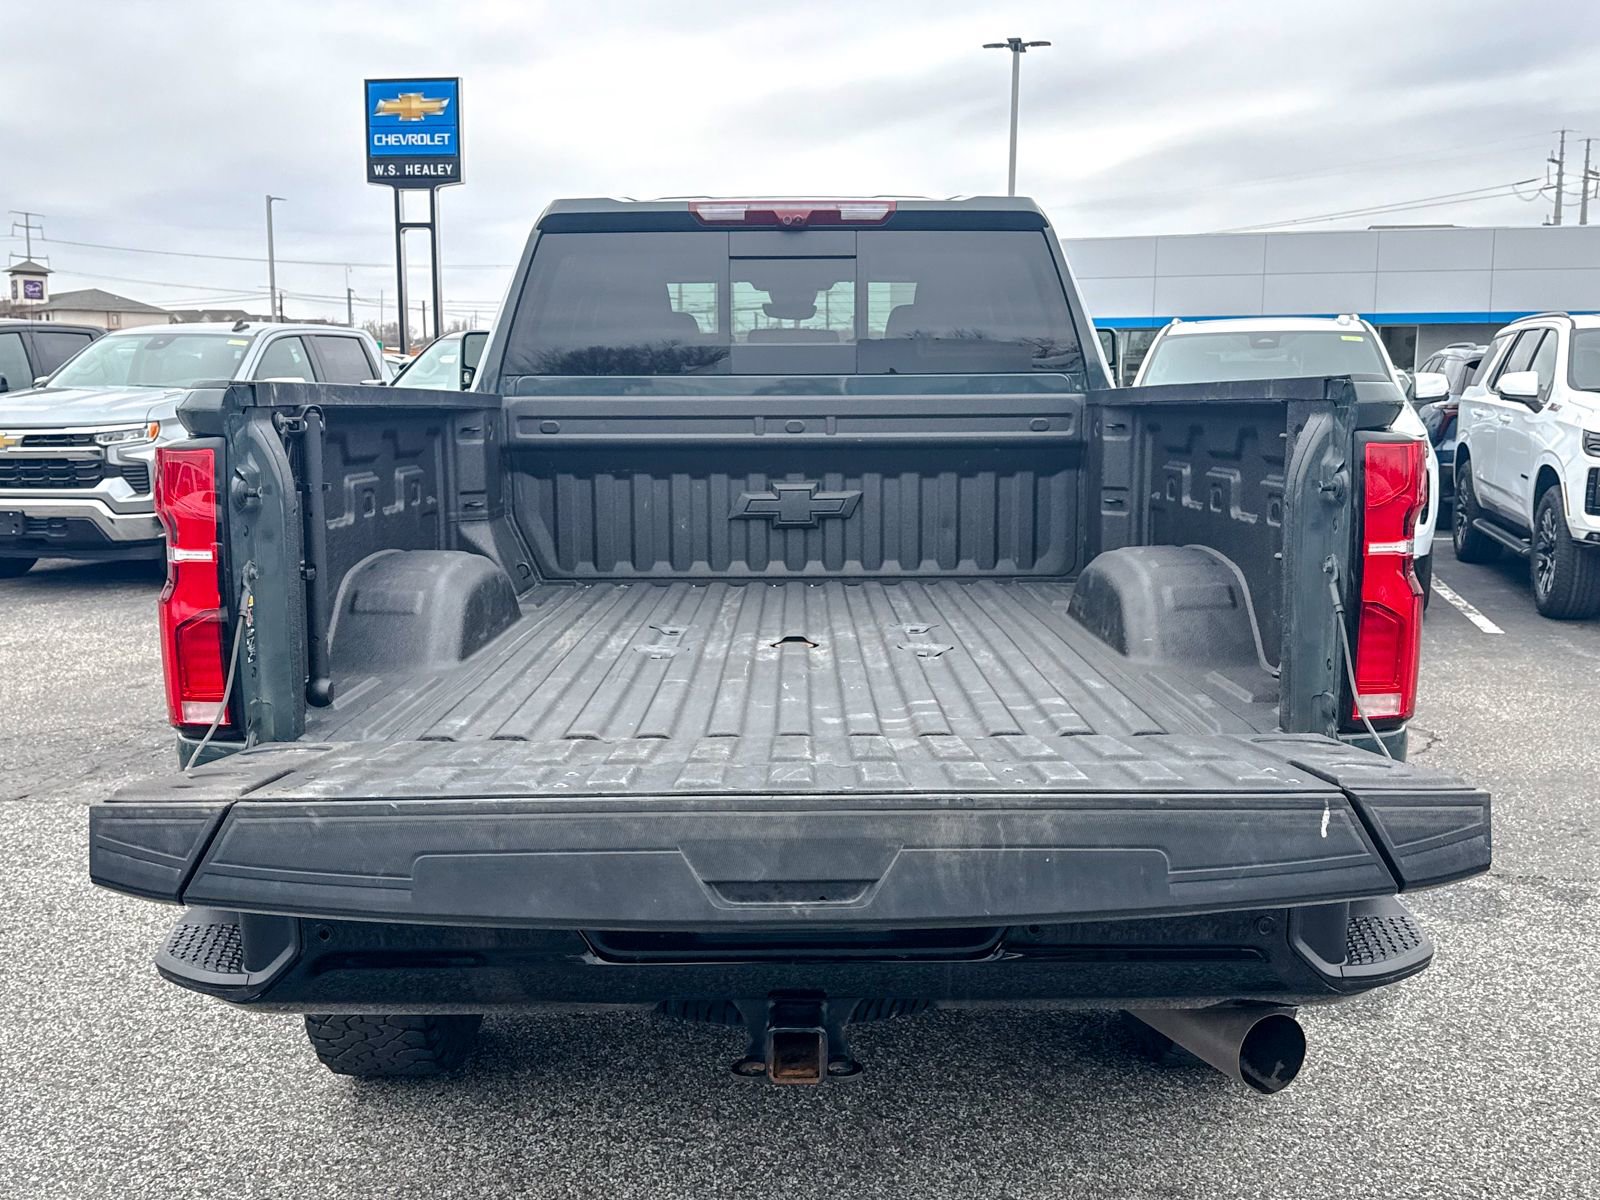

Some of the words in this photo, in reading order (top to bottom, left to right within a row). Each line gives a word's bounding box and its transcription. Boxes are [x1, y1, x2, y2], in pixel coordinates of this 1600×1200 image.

[373, 133, 451, 146] CHEVROLET
[373, 164, 400, 176] W.S.
[405, 164, 453, 176] HEALEY
